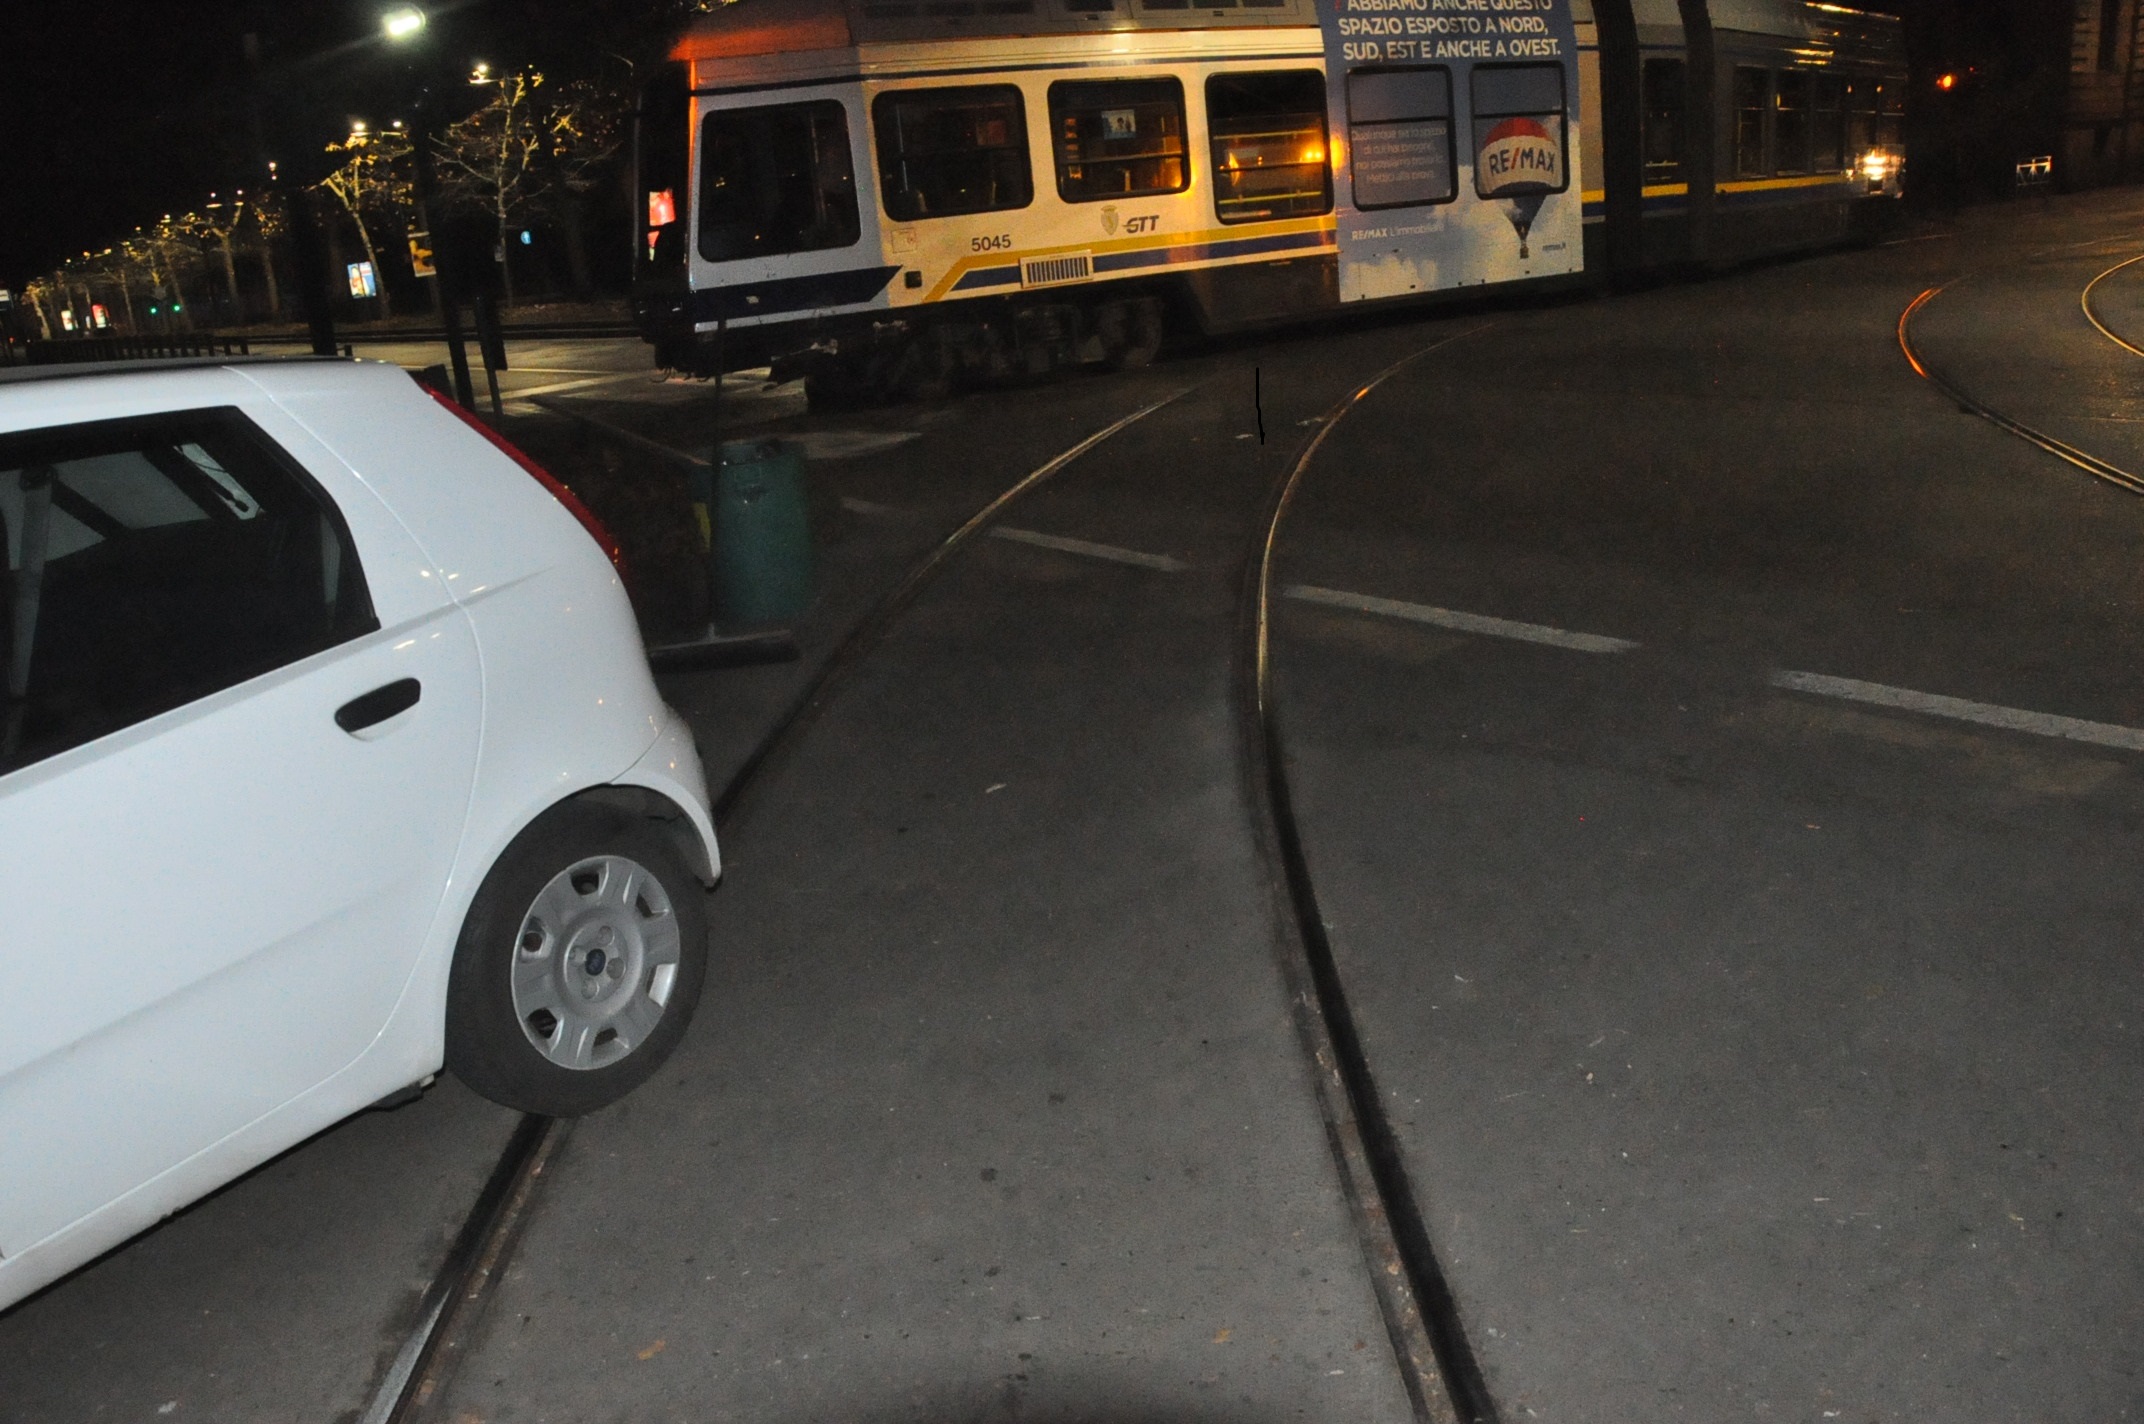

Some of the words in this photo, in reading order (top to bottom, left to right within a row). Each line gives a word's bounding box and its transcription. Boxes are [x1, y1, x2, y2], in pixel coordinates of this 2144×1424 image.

[1348, 0, 1427, 11] ABBIAMO
[1432, 0, 1489, 11] ANCHE
[1491, 0, 1552, 11] QUESTO
[1338, 17, 1402, 35] SPAZIO
[1405, 17, 1481, 34] ESPOSTO
[1486, 17, 1497, 33] A
[1499, 17, 1549, 35] NORD,
[1343, 42, 1383, 62] SUD,
[1387, 41, 1417, 59] EST
[1421, 41, 1432, 58] E
[1436, 40, 1493, 58] ANCHE
[1495, 40, 1507, 57] A
[1510, 38, 1562, 57] OVEST.
[1489, 146, 1556, 177] RE/MAX
[971, 234, 1011, 252] 5045
[1352, 228, 1388, 240] RE/MAX
